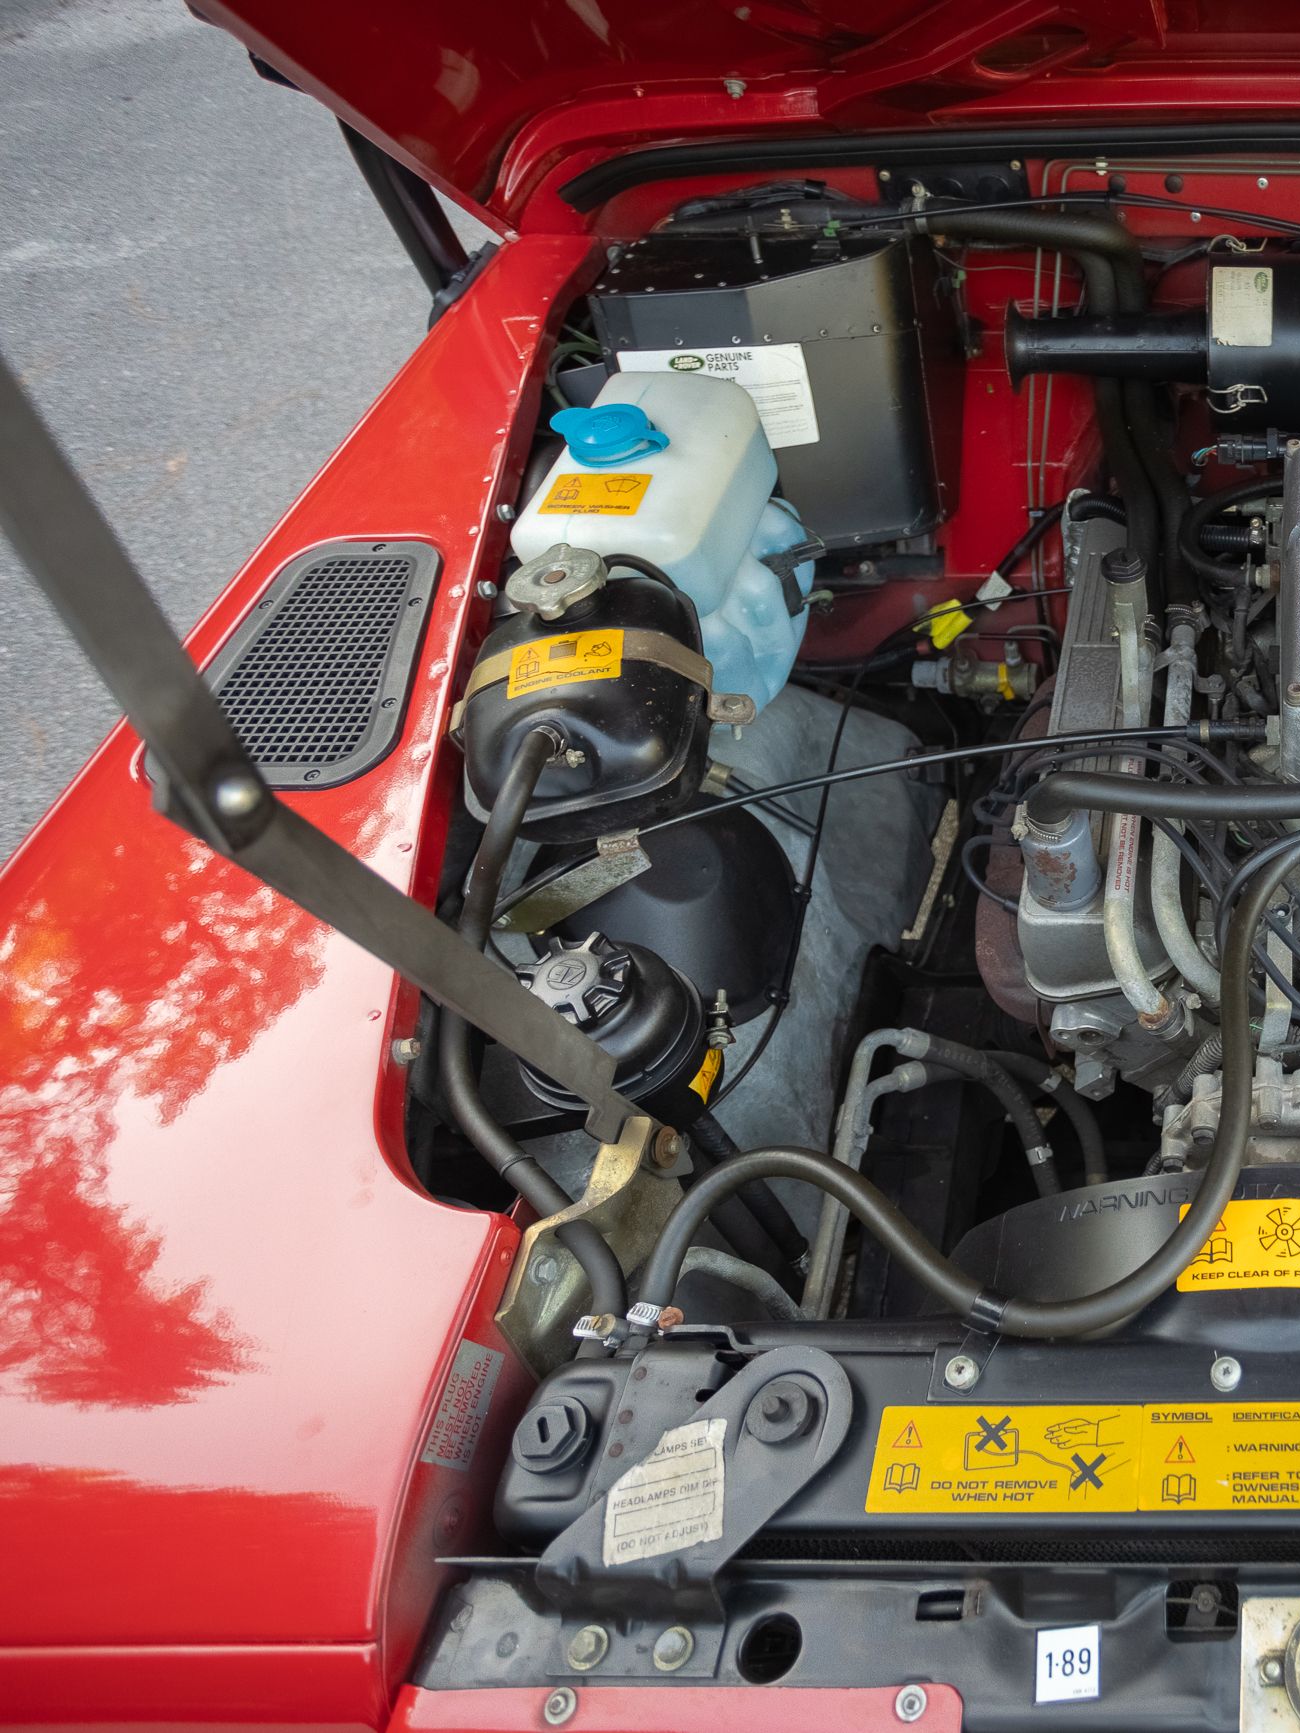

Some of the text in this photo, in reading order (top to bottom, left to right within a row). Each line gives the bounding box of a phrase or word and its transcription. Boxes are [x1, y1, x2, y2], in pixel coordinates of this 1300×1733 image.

[706, 352, 753, 362] GENUINE
[708, 362, 739, 372] PARTS
[514, 667, 612, 692] ENGINE COOLANT
[1127, 837, 1135, 865] ENGINE
[1114, 851, 1124, 890] REMOVED
[1059, 1187, 1190, 1222] WARNING
[1192, 1272, 1225, 1281] KEEP
[1228, 1269, 1270, 1279] CLEAR
[1273, 1269, 1290, 1278] OF
[427, 1372, 460, 1453] THIS PLUG
[444, 1361, 481, 1460] BE REMOVED
[452, 1353, 493, 1460] WHEN ENGINE
[437, 1376, 468, 1458] MUST NOT
[1151, 1412, 1213, 1422] SYMBOL
[461, 1415, 482, 1464] IS HOT
[930, 1480, 1058, 1490] DO NOT REMOVE
[1232, 1472, 1280, 1480] REFER
[1232, 1482, 1300, 1492] OWNERS
[613, 1489, 676, 1510] HEADLAMPS
[680, 1483, 699, 1495] DIM
[951, 1492, 1035, 1502] WHEN HOT
[1232, 1494, 1299, 1504] MANUAL
[640, 1535, 661, 1546] NOT
